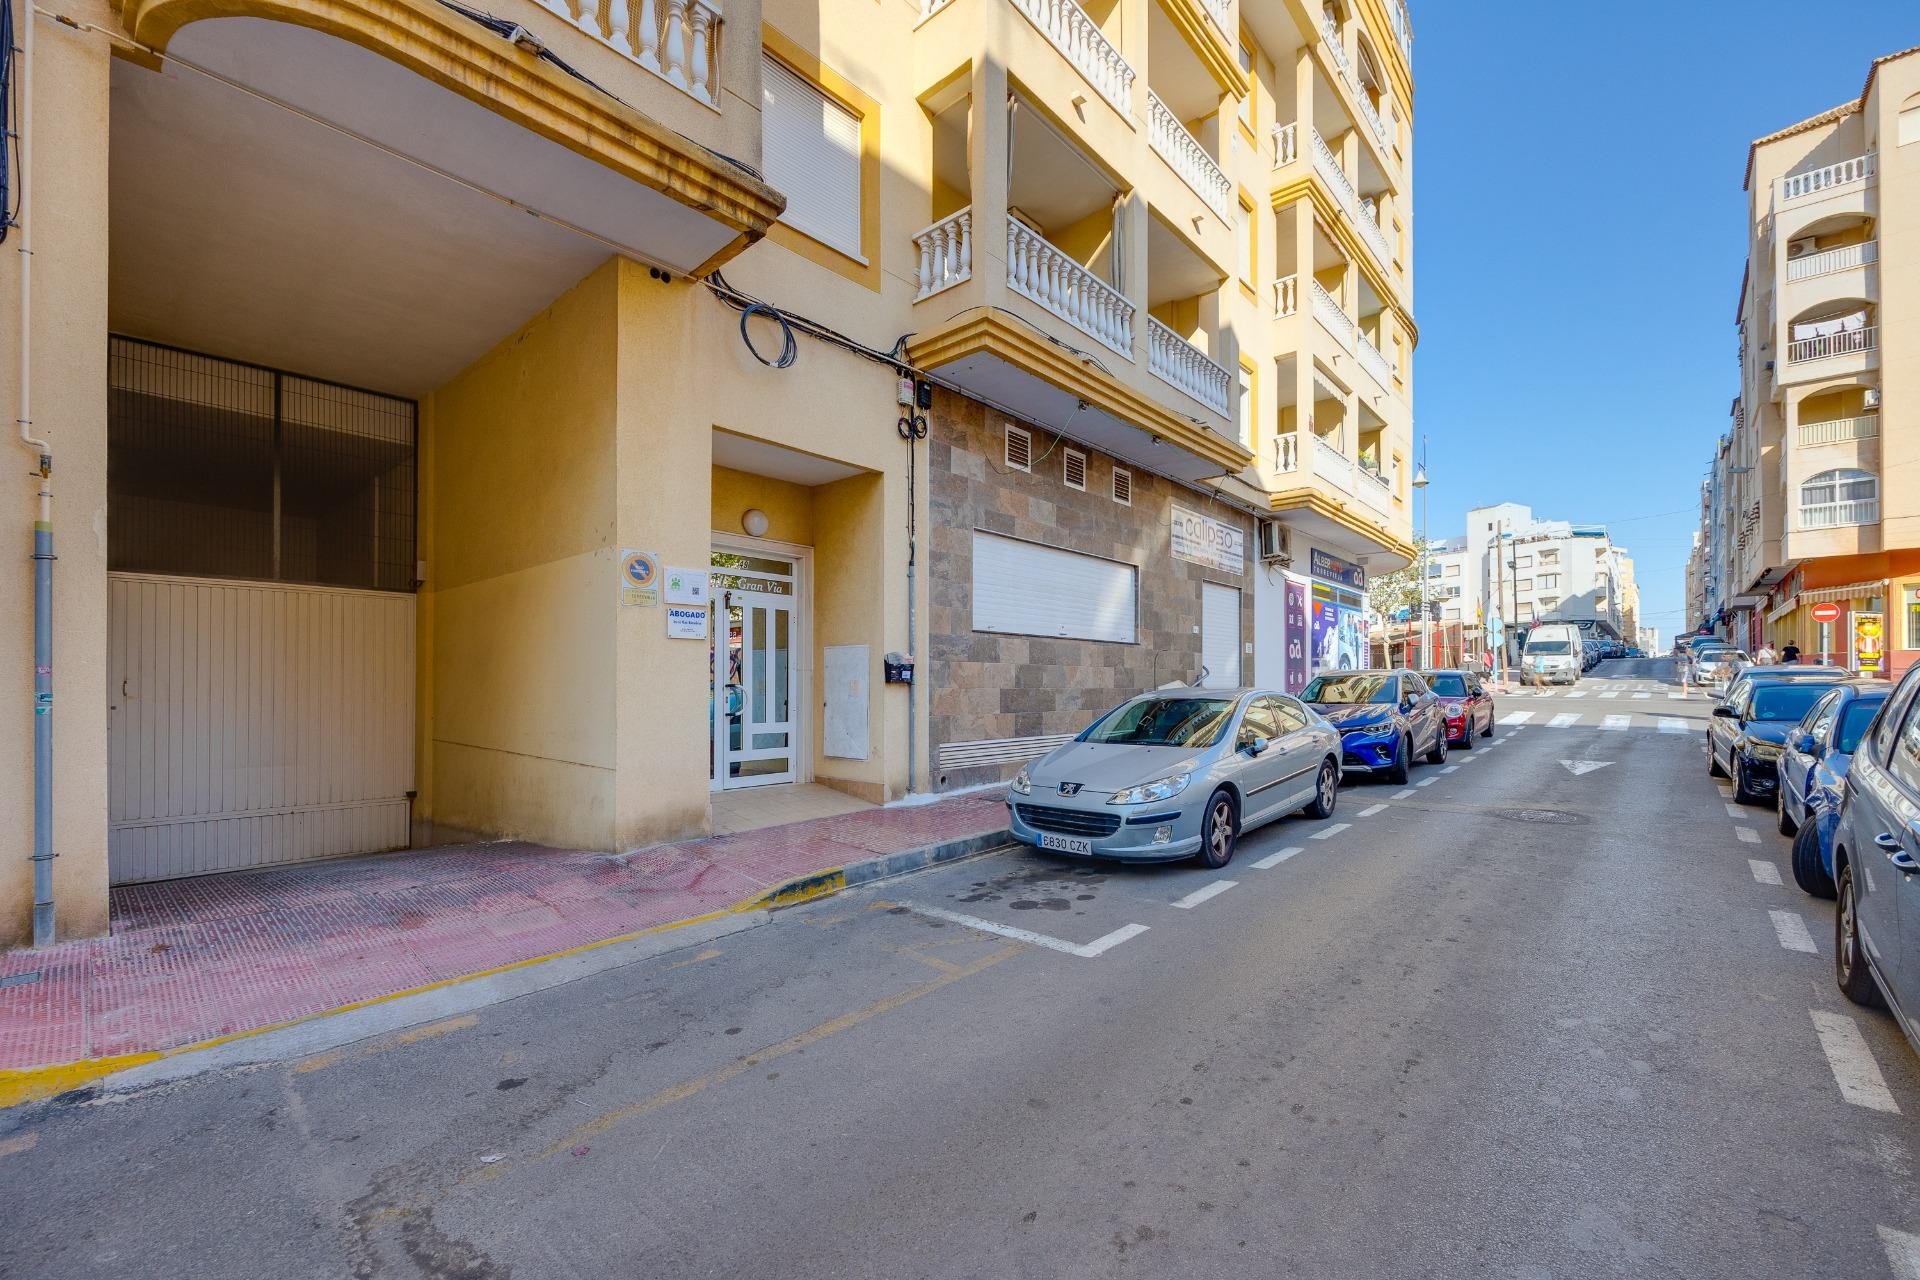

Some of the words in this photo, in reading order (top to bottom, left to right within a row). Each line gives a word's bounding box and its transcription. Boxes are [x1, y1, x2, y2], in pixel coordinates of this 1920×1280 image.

[1185, 518, 1233, 549] calipso
[738, 577, 763, 591] Gran
[669, 610, 706, 619] ABOGADO
[1043, 836, 1067, 849] 6830
[1070, 840, 1089, 853] CZK
